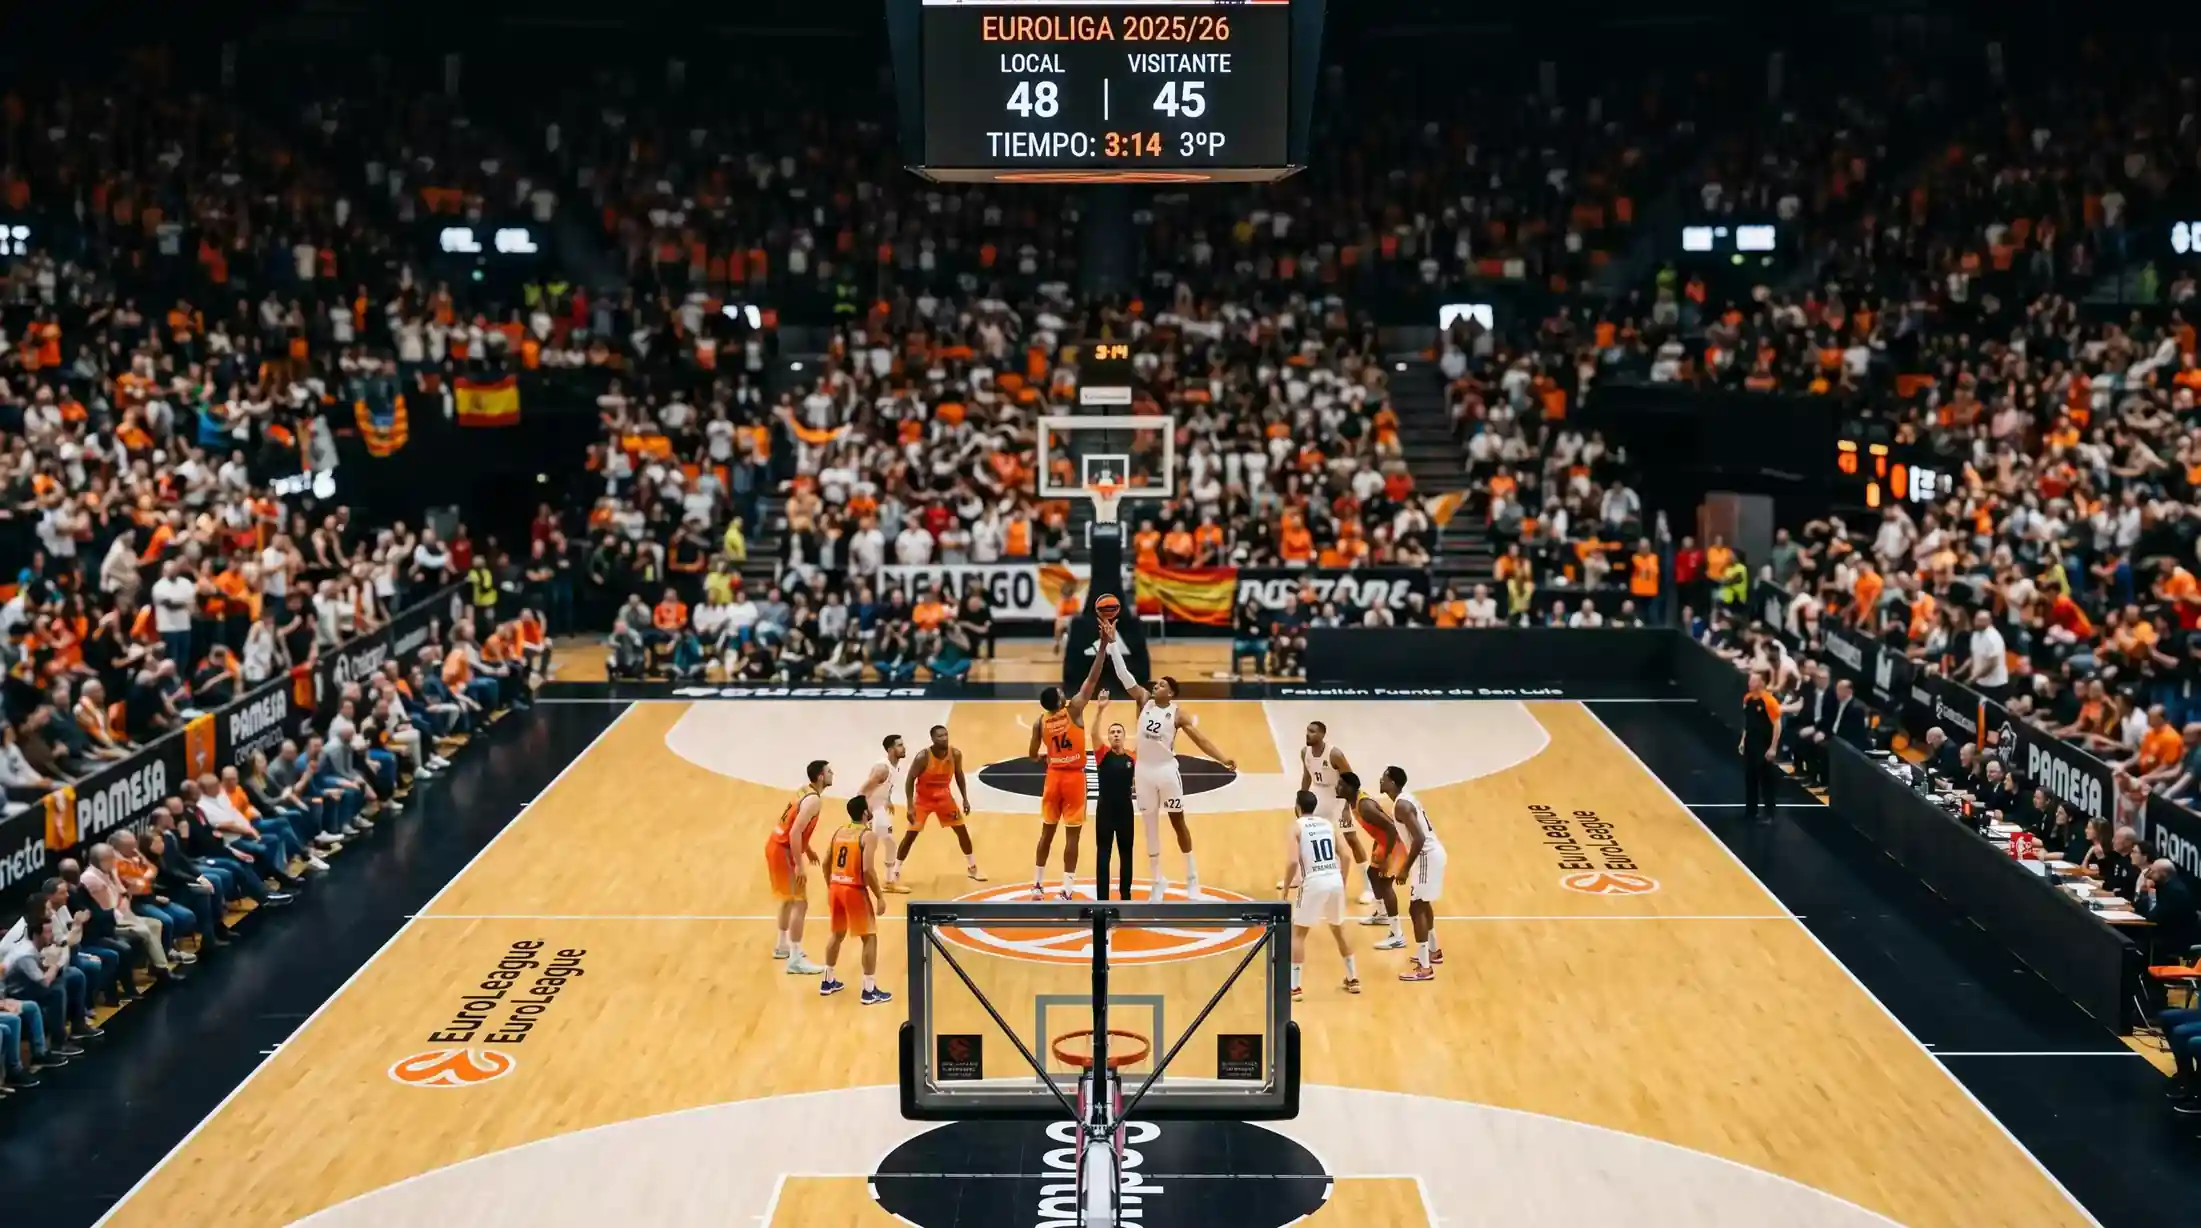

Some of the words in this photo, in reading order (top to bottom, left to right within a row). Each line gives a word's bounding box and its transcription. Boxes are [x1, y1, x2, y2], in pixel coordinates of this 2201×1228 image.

[983, 16, 1115, 41] EUROLIGA
[1123, 16, 1229, 42] 2025/26
[1001, 53, 1065, 73] LOCAL
[1127, 53, 1231, 73] VISITANTE
[1006, 80, 1059, 118] 48
[1153, 80, 1206, 118] 45
[986, 132, 1096, 157] TIEMPO:
[1104, 132, 1162, 157] 3:14
[230, 689, 286, 746] PAMESA
[1146, 719, 1161, 733] 22
[1052, 731, 1072, 752] 14
[2028, 742, 2102, 818] PAMESA
[78, 759, 165, 842] PAMESA
[1168, 798, 1181, 809] 22
[837, 846, 849, 868] 8
[1311, 838, 1334, 863] 10
[427, 939, 545, 1042] EuroLeague
[483, 948, 587, 1043] EuroLeague
